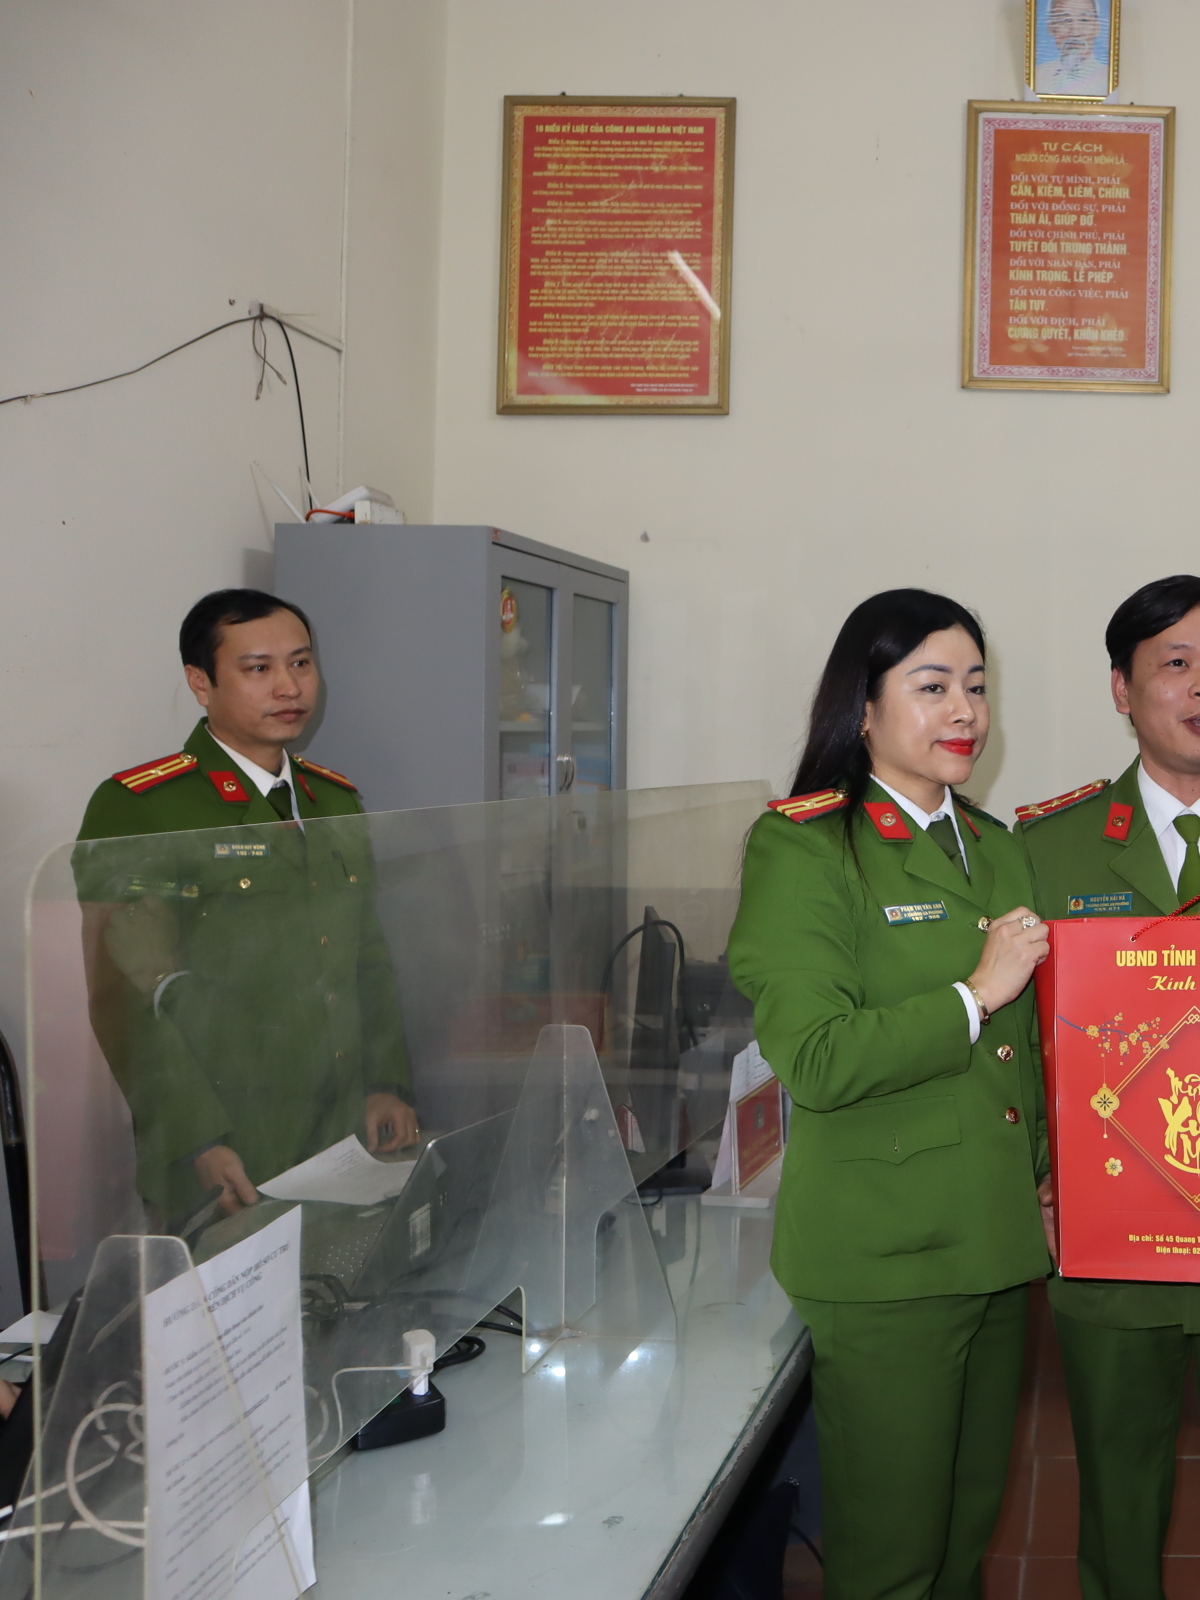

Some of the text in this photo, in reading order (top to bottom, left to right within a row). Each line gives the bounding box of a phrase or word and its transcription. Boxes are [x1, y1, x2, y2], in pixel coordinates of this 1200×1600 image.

[1042, 141, 1103, 152] TƯ CÁCH
[1011, 173, 1121, 186] ĐỐI VỚI TỰ MÌNH, PHẢI
[1010, 199, 1126, 213] ĐỐI VỚI ĐỒNG SỰ, PHẢI
[1010, 210, 1036, 224] THÂN
[1039, 211, 1052, 226] ÁI,
[1054, 211, 1078, 226] GIÚP
[1010, 228, 1126, 240] ĐỐI VỚI CHÍNH PHỦ, PHẢI
[1010, 238, 1130, 256] TUYỆT ĐỐI TRUNG THÀNH.
[1010, 256, 1121, 269] ĐỐI VỚI NHÂN DÂN, PHẢI
[1009, 268, 1116, 284] KÍNH TRỌNG, LỄ PHÉP.
[1010, 286, 1129, 299] ĐỐI VỚI CÔNG VIỆC, PHẢI
[1009, 298, 1026, 313] TẬN
[1009, 314, 1107, 327] ĐỐI VỚI ĐỊCH, PHẢI
[1116, 950, 1158, 966] UBND
[1162, 944, 1196, 966] TỈNH
[1147, 975, 1196, 991] Kính
[1128, 1234, 1140, 1242] Địa
[1142, 1234, 1154, 1242] chỉ:
[1156, 1234, 1164, 1242] Số
[1176, 1235, 1196, 1244] Quang
[1156, 1246, 1170, 1254] Điện
[1172, 1246, 1191, 1256] thoại:
